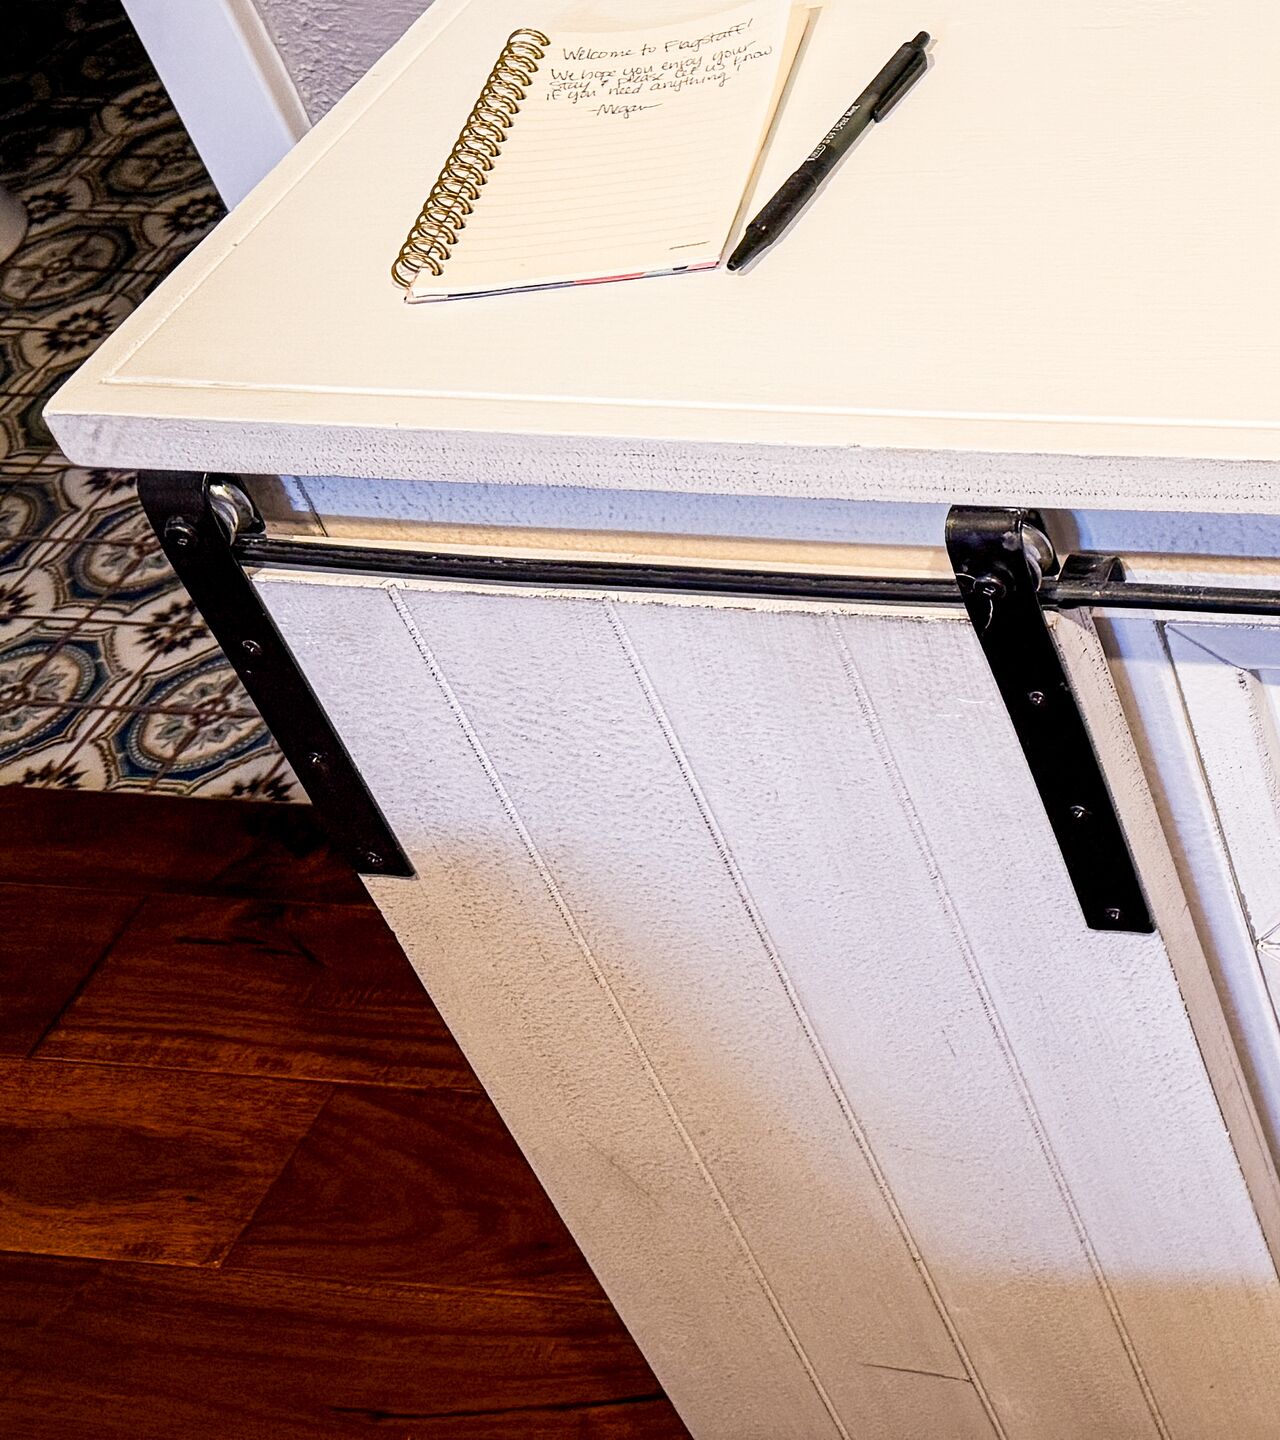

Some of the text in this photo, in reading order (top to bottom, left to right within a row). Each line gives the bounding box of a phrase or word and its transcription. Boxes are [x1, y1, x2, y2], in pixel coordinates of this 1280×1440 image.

[563, 46, 633, 60] Welcome
[641, 44, 656, 56] to
[551, 68, 578, 80] We
[623, 65, 653, 80] you
[661, 56, 702, 72] enjoy
[567, 91, 596, 104] you
[608, 83, 644, 95] need
